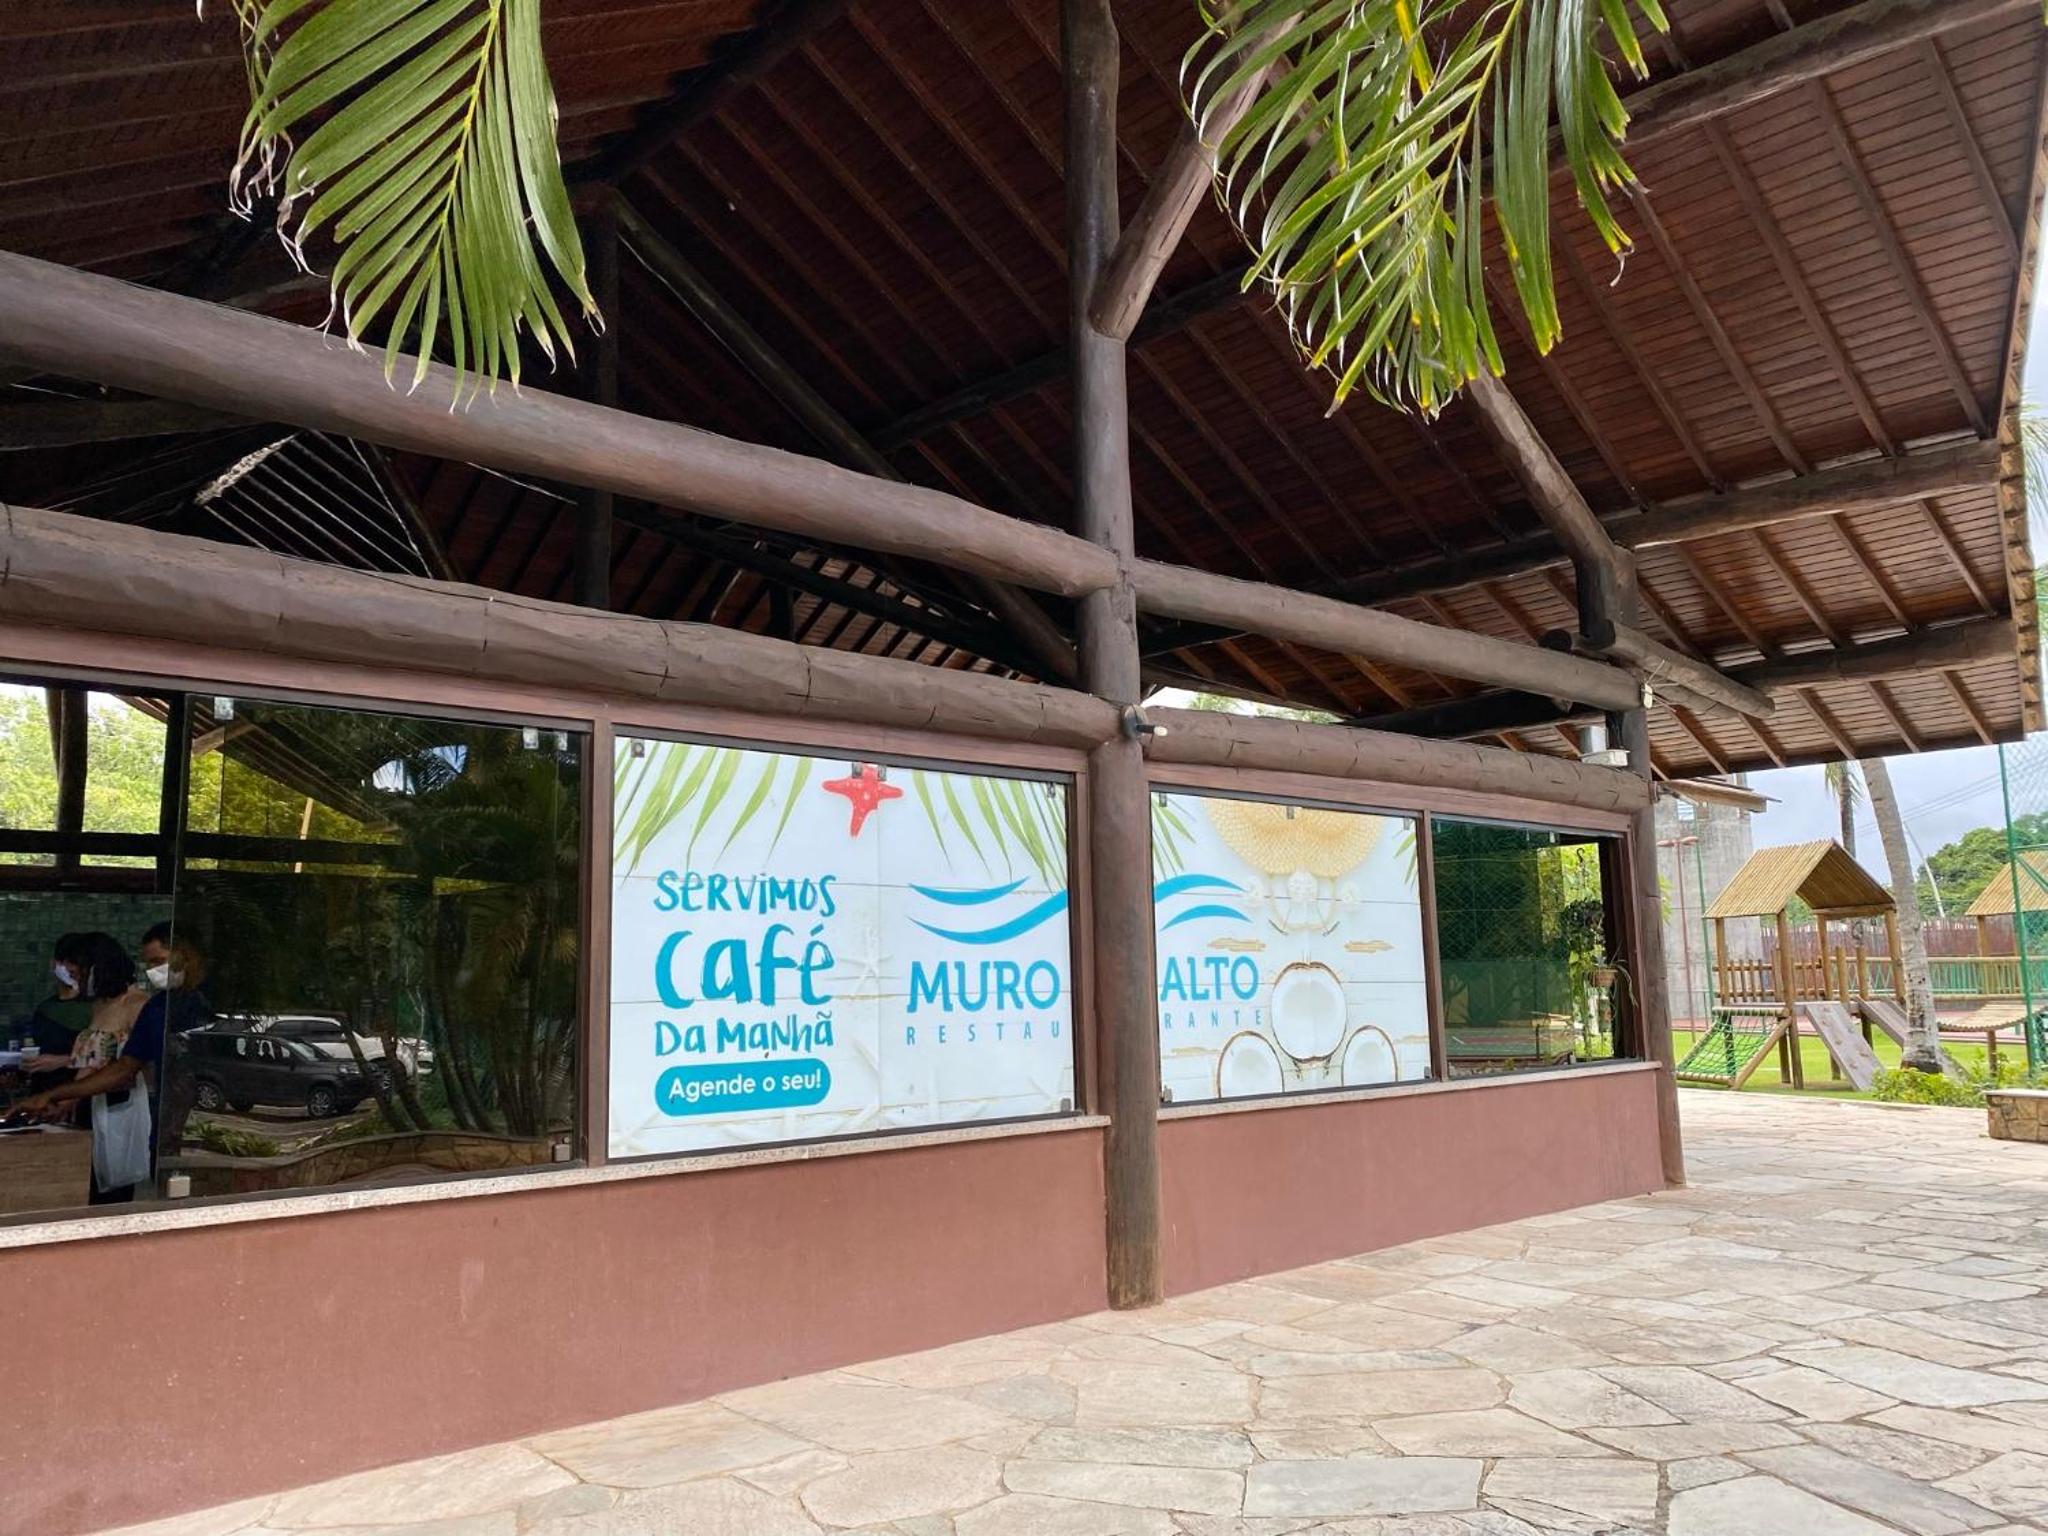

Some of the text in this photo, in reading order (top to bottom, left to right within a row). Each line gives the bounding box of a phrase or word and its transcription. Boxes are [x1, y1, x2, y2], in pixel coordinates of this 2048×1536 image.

[654, 923, 835, 1010] Café
[906, 956, 1259, 1013] MURO ALTO
[668, 1069, 822, 1103] Agende o seu!
